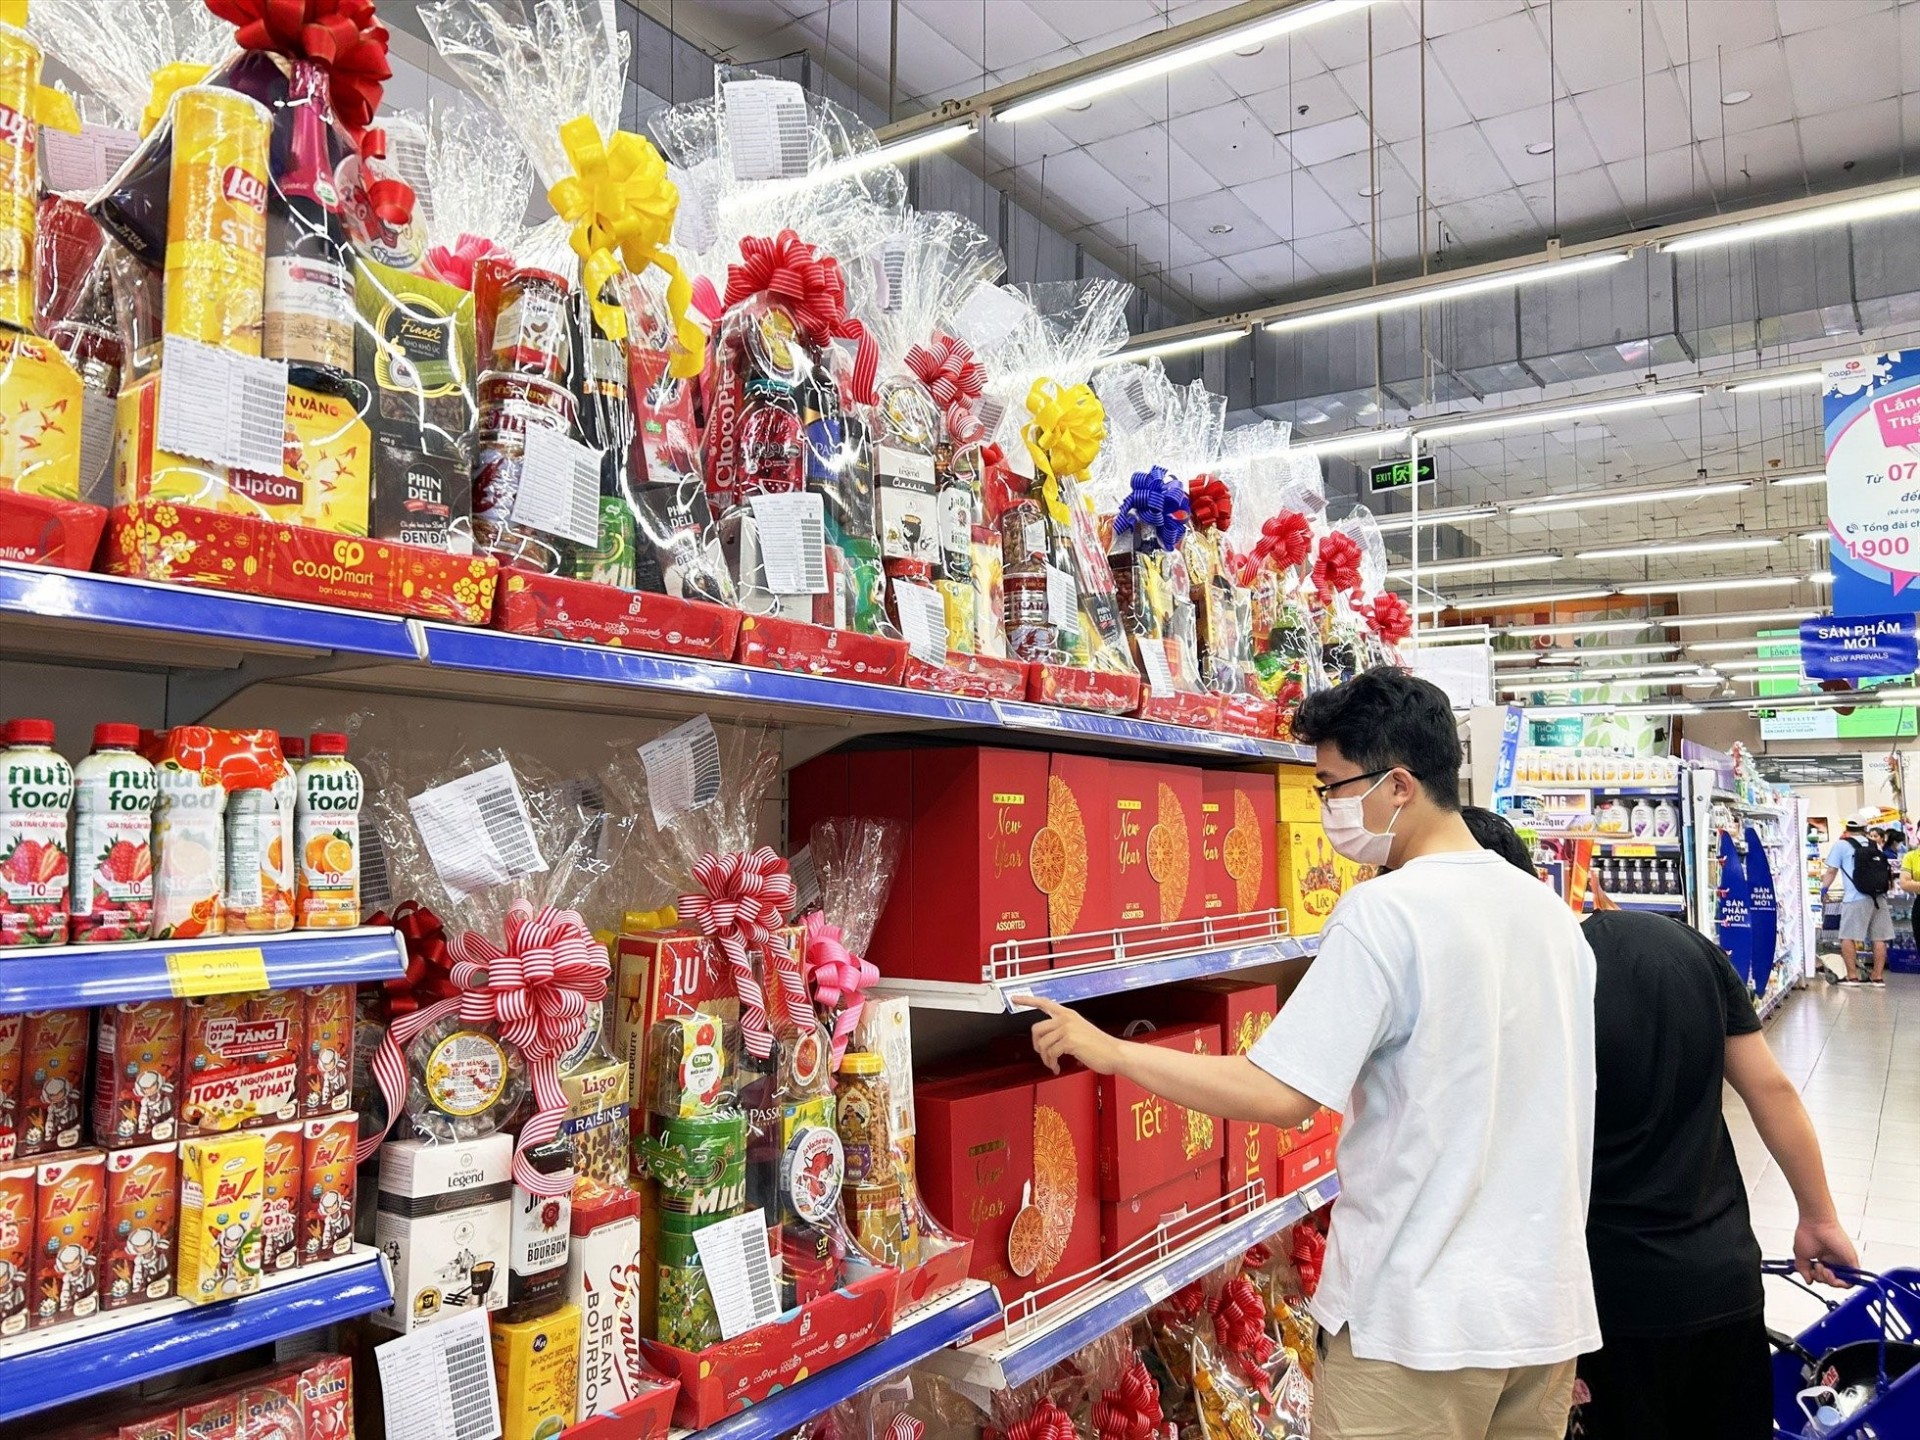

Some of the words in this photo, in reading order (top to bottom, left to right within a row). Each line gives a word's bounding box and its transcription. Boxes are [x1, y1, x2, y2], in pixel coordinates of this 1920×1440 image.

[0, 107, 36, 148] ay's
[226, 167, 267, 214] Lay
[221, 218, 265, 252] STA
[400, 316, 442, 340] Finest
[300, 395, 340, 418] VÀNG
[715, 369, 737, 488] ChocoPie
[1887, 409, 1920, 429] Thấ
[233, 474, 298, 501] Lipton
[407, 471, 442, 491] PHIN
[1374, 471, 1392, 484] EXIT
[1865, 474, 1884, 485] Từ
[407, 486, 442, 504] DELI
[666, 504, 691, 518] PH
[670, 514, 695, 528] DELI
[401, 531, 428, 544] ĐEN
[1862, 522, 1889, 534] Tổng
[1891, 520, 1908, 530] đài
[1846, 536, 1910, 560] 1900
[1818, 624, 1850, 640] SẢN
[1854, 620, 1901, 636] PHẨM
[1843, 636, 1877, 650] MỚI
[1829, 654, 1849, 664] NEW
[1850, 652, 1889, 662] ARRIVALS
[8, 762, 72, 785] nuti
[109, 766, 157, 789] nut
[308, 769, 360, 792] nuti
[8, 787, 72, 809] food
[307, 792, 360, 811] food
[988, 806, 1023, 840] New
[1114, 811, 1141, 840] New
[994, 842, 1024, 879] Year
[1118, 841, 1142, 874] Year
[29, 883, 46, 897] 10
[128, 881, 141, 894] 10
[324, 873, 340, 885] 10
[1722, 906, 1748, 914] PHẨM
[1725, 899, 1744, 907] SẢN
[996, 920, 1026, 931] ASSORTED
[1726, 914, 1745, 922] MỚI
[673, 956, 700, 997] LU
[210, 1023, 235, 1033] MUA
[210, 1032, 223, 1042] 01
[236, 1028, 276, 1046] TẶNG
[274, 1022, 285, 1040] 1
[194, 1079, 240, 1105] 100%
[240, 1071, 275, 1087] NGUYÊN
[276, 1067, 294, 1079] BẢN
[250, 1084, 266, 1102] TỪ
[266, 1080, 292, 1098] HẠT
[582, 1076, 616, 1096] Ligo
[576, 1106, 622, 1132] RAISINS
[750, 1105, 782, 1124] PASSI
[1130, 1094, 1162, 1142] Tết
[1244, 1123, 1260, 1183] Tết
[448, 1170, 484, 1188] Legend
[263, 1202, 271, 1213] 2
[527, 1239, 567, 1263] BOURBON
[585, 1291, 600, 1421] BOURBON
[600, 1314, 614, 1387] BEAM
[306, 1378, 346, 1400] GAIN
